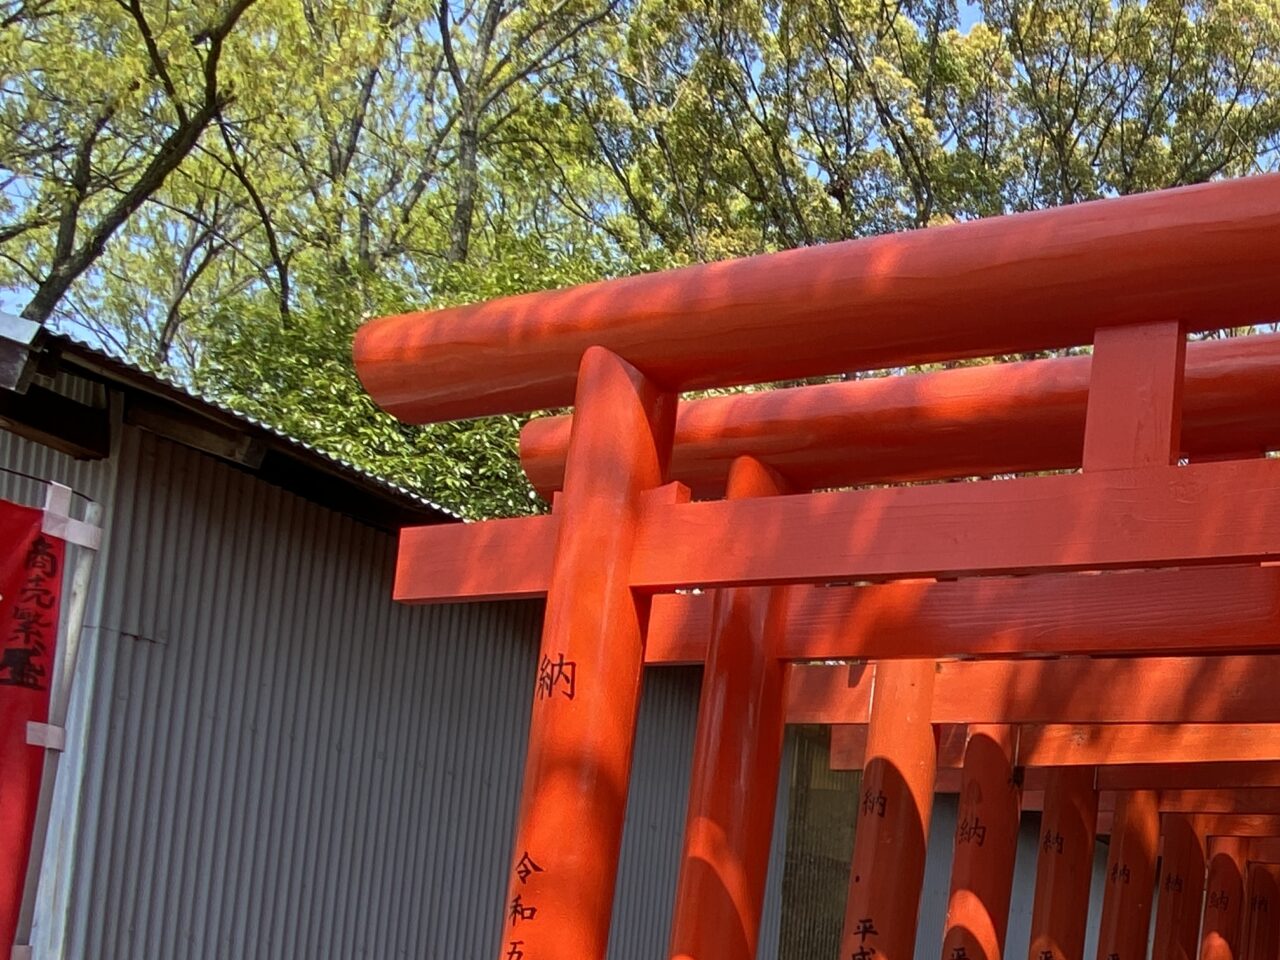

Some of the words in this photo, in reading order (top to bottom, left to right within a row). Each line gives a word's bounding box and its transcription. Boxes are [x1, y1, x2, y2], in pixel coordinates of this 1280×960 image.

[536, 653, 577, 700] 納
[863, 789, 887, 818] 納
[957, 817, 986, 848] 納
[1042, 829, 1065, 855] 納
